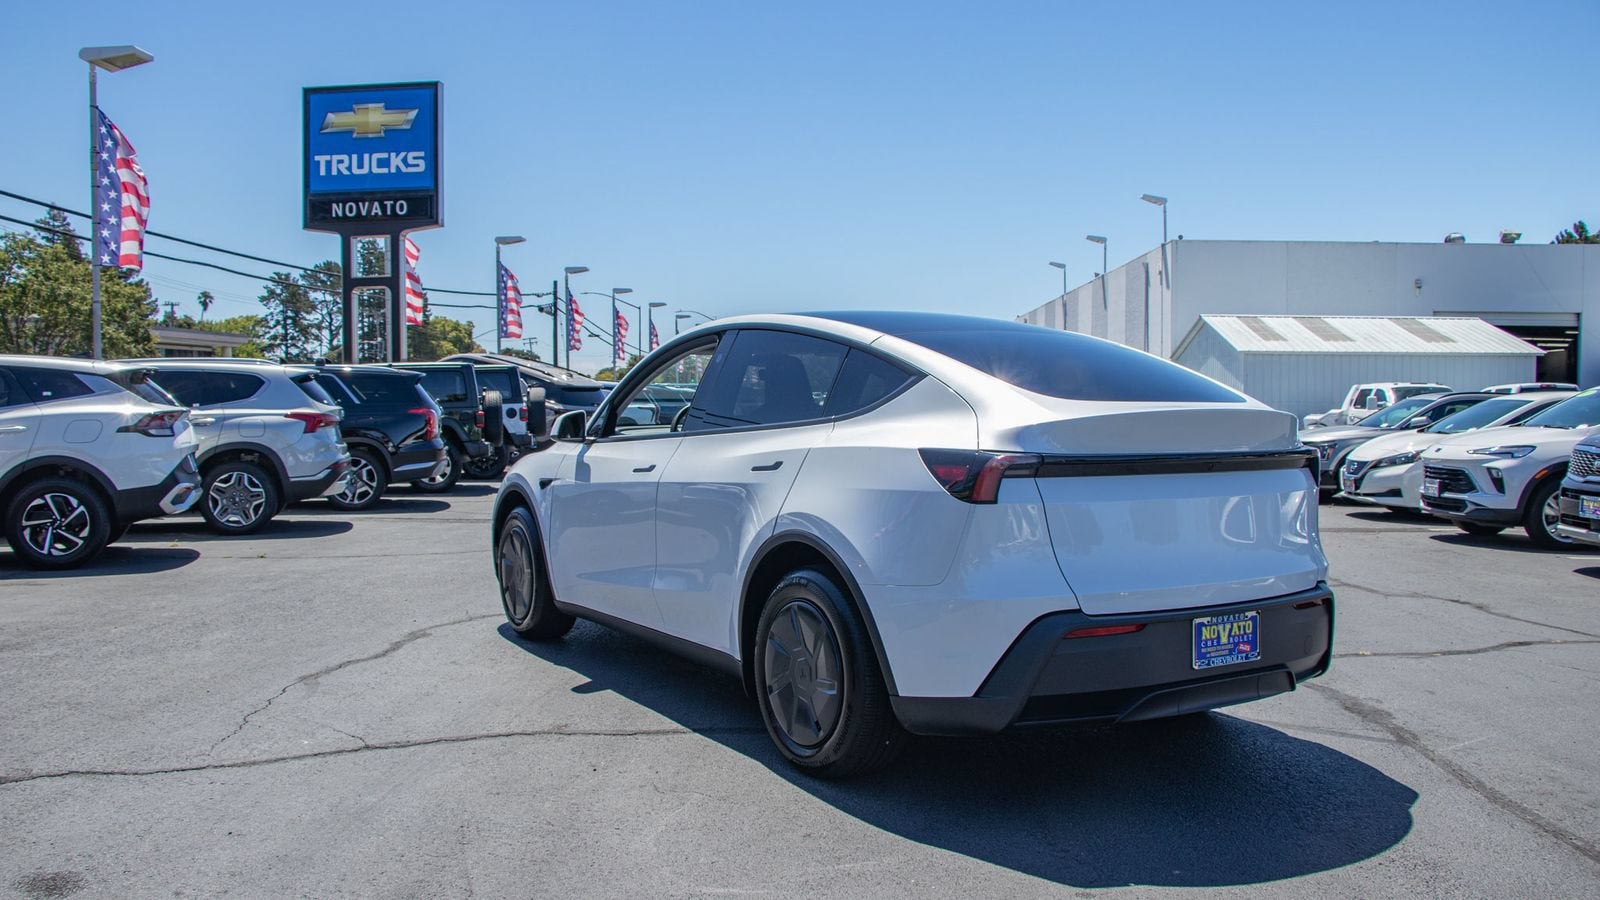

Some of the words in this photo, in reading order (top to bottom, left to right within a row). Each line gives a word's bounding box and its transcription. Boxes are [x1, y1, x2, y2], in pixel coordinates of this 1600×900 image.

[314, 151, 426, 176] TRUCKS
[332, 200, 408, 218] NOVATO
[1212, 613, 1245, 624] NOVATO
[1201, 620, 1253, 643] NOVATO
[1210, 653, 1247, 666] CHEVROLET
